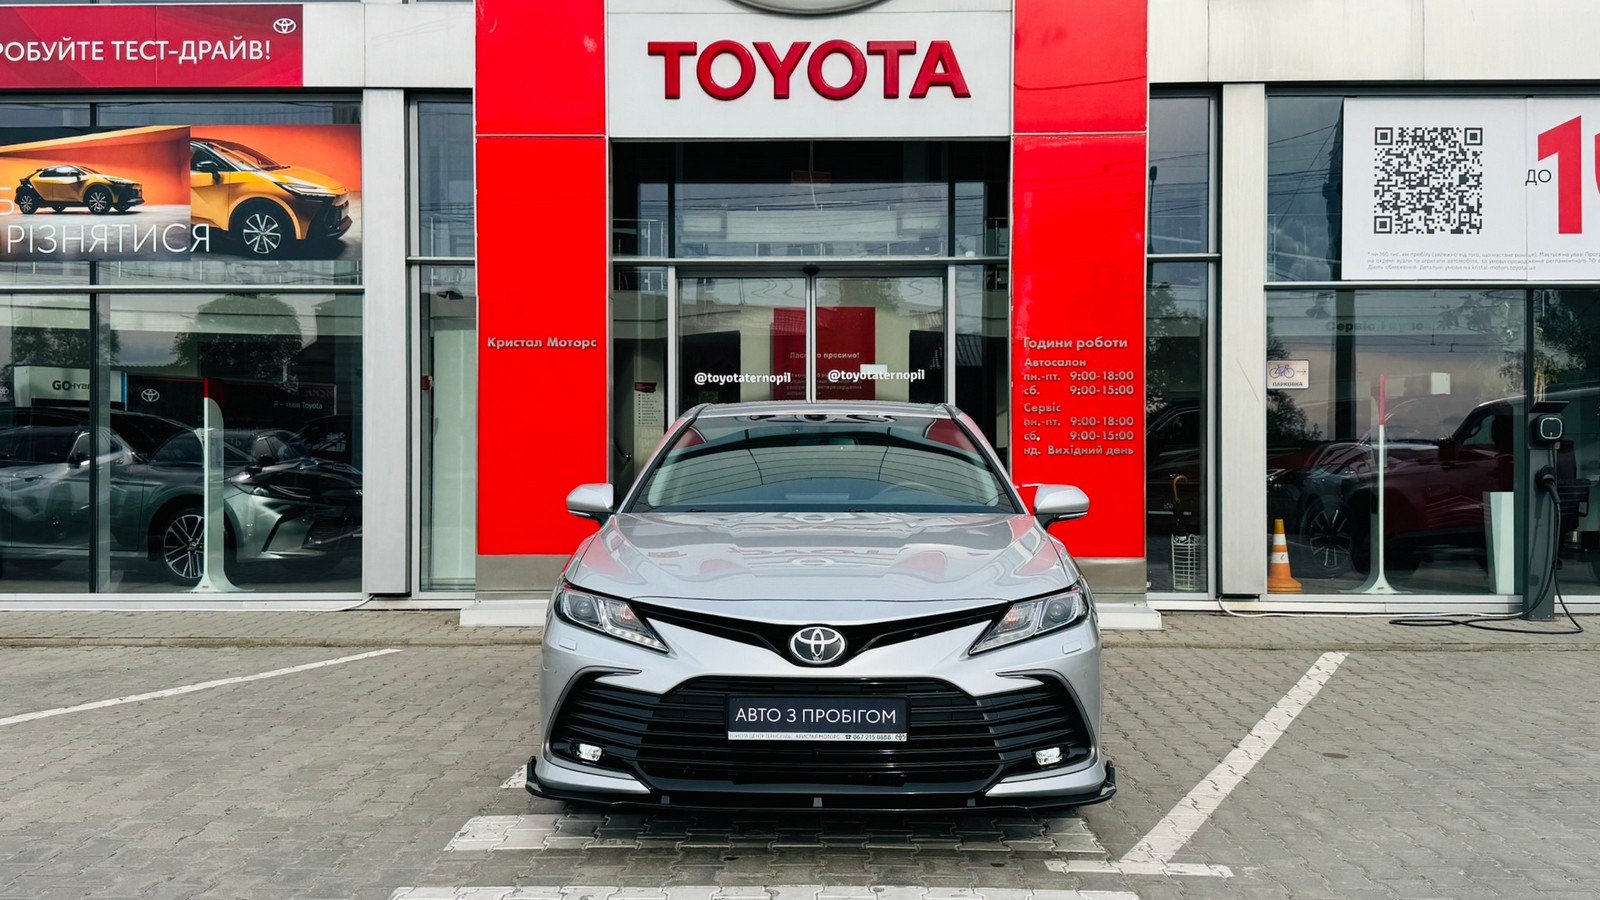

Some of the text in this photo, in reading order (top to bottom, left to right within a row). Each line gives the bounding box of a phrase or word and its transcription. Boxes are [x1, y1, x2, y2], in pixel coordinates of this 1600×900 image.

[111, 36, 271, 64] ТЕСТ-ДРАЙВ!
[647, 39, 971, 101] TOYOTA
[1537, 114, 1600, 234] 1
[7, 223, 210, 253] РІЗНЯТИСЯ
[487, 337, 597, 349] Кристал Моторс
[1023, 336, 1128, 351] Години роботи
[1024, 358, 1086, 367] Автосалон
[694, 372, 791, 385] @toyotaternopil
[828, 369, 925, 383] @toyotaternopil
[1024, 371, 1134, 381] пн.-пт. 9:00-18:00
[1024, 385, 1134, 395] сб. 9:00-15:00
[301, 401, 323, 410] Toyota
[1024, 402, 1061, 414] Сервіс
[1070, 417, 1134, 426] 9:00-18:00
[1024, 430, 1134, 441] сб. 9:00-15:00
[1024, 444, 1134, 456] нд. Вихідний день
[735, 708, 896, 724] АВТО З ПРОБІГОМ
